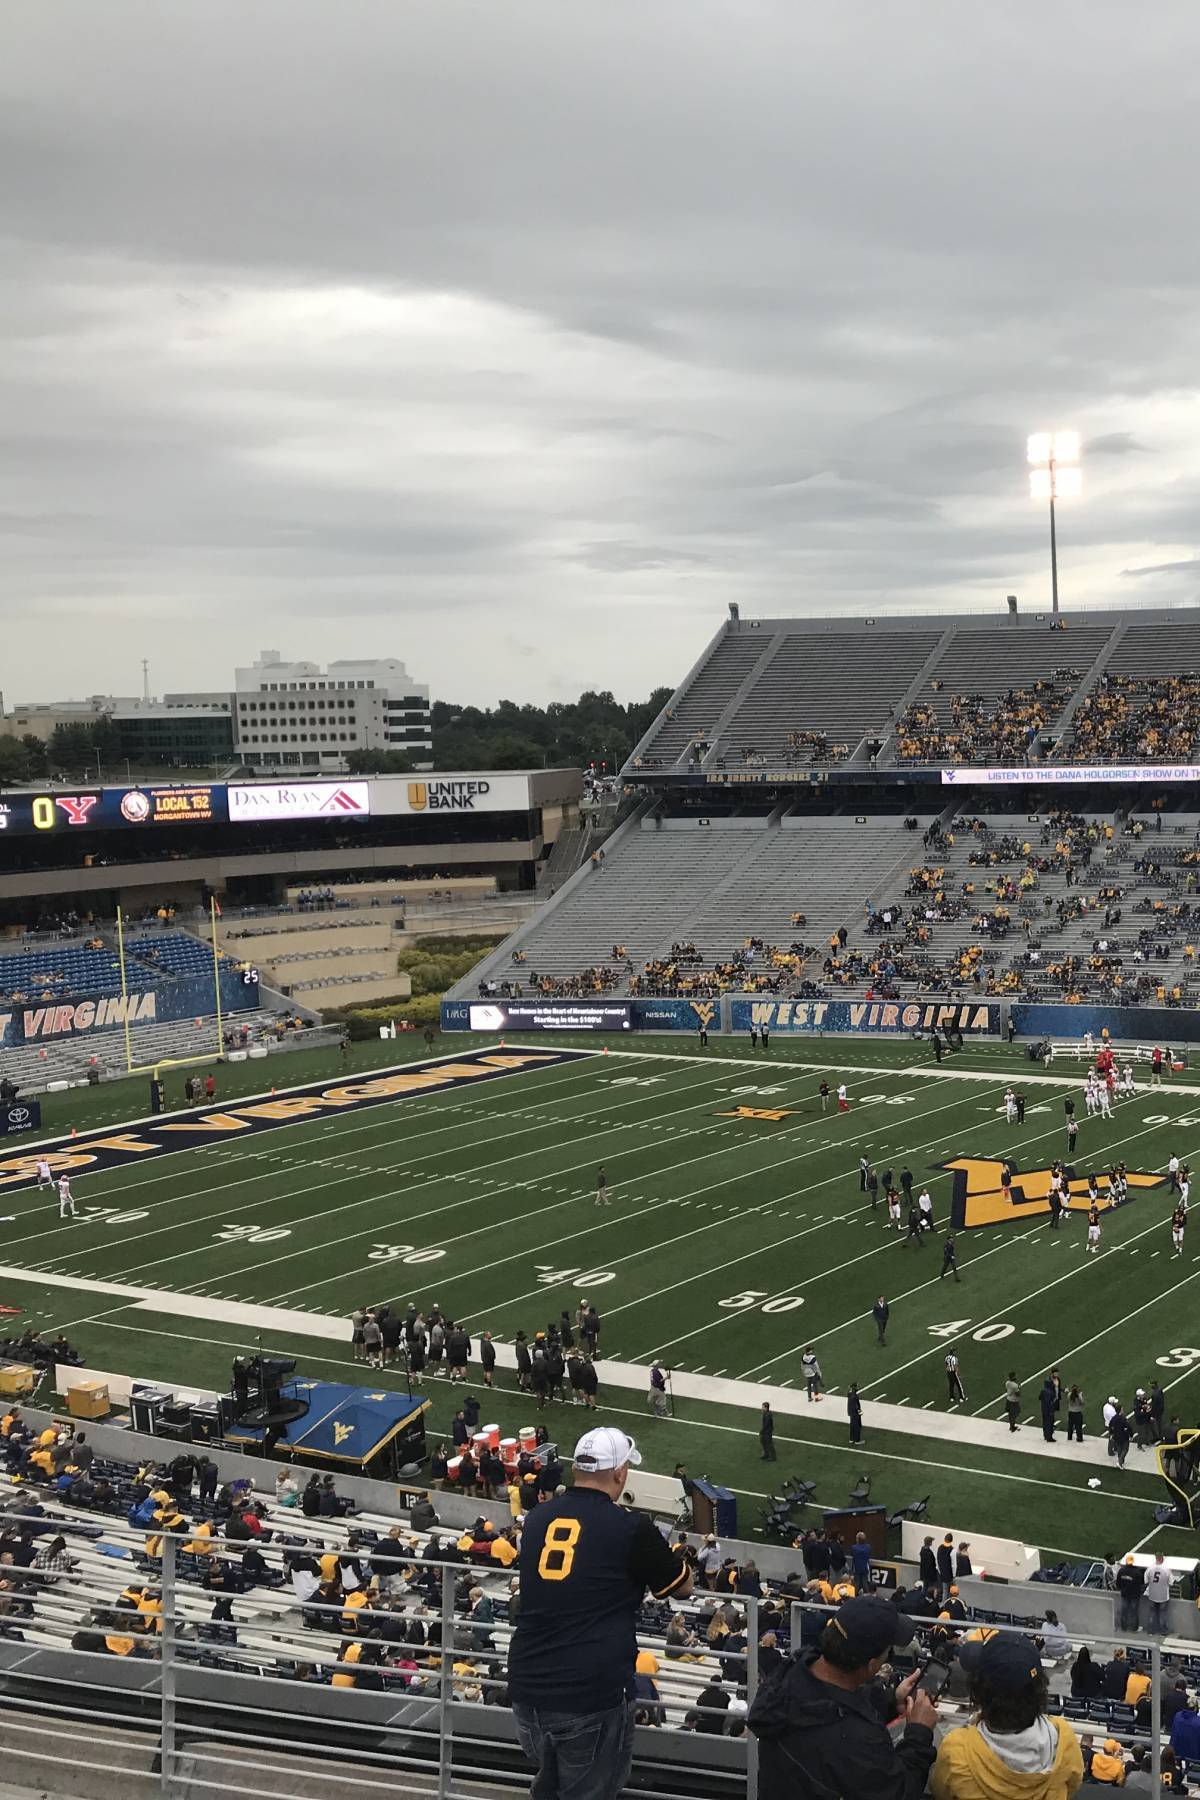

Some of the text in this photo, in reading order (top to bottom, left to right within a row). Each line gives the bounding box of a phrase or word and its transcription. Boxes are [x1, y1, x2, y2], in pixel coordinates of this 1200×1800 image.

[988, 771, 1019, 780] LISTEN
[1020, 770, 1034, 780] TO
[1036, 770, 1054, 780] THE
[1056, 770, 1082, 780] DANA
[1084, 770, 1140, 779] HOLGORSEN
[1142, 768, 1172, 778] SHOW
[1174, 768, 1189, 778] ON
[235, 788, 320, 806] DAN RYAN
[428, 781, 490, 795] UNITED
[156, 796, 209, 811] LOCAL 152
[428, 795, 475, 809] BANK
[154, 812, 200, 821] MORGANTOWN
[23, 992, 156, 1039] VIRGINIA
[446, 1010, 468, 1019] IMG
[533, 1016, 560, 1024] Starting
[560, 1016, 566, 1024] in
[568, 1016, 579, 1024] the
[645, 1011, 677, 1019] NISSAN
[751, 1002, 989, 1029] WEST VIRGINIA
[152, 1054, 562, 1133] VIRGINIA
[212, 1224, 292, 1244] 20
[368, 1244, 447, 1264] 30
[537, 1268, 616, 1288] 40
[718, 1291, 805, 1313] 50
[928, 1317, 1017, 1342] 40
[538, 1518, 582, 1581] 8
[1152, 1571, 1161, 1584] 5
